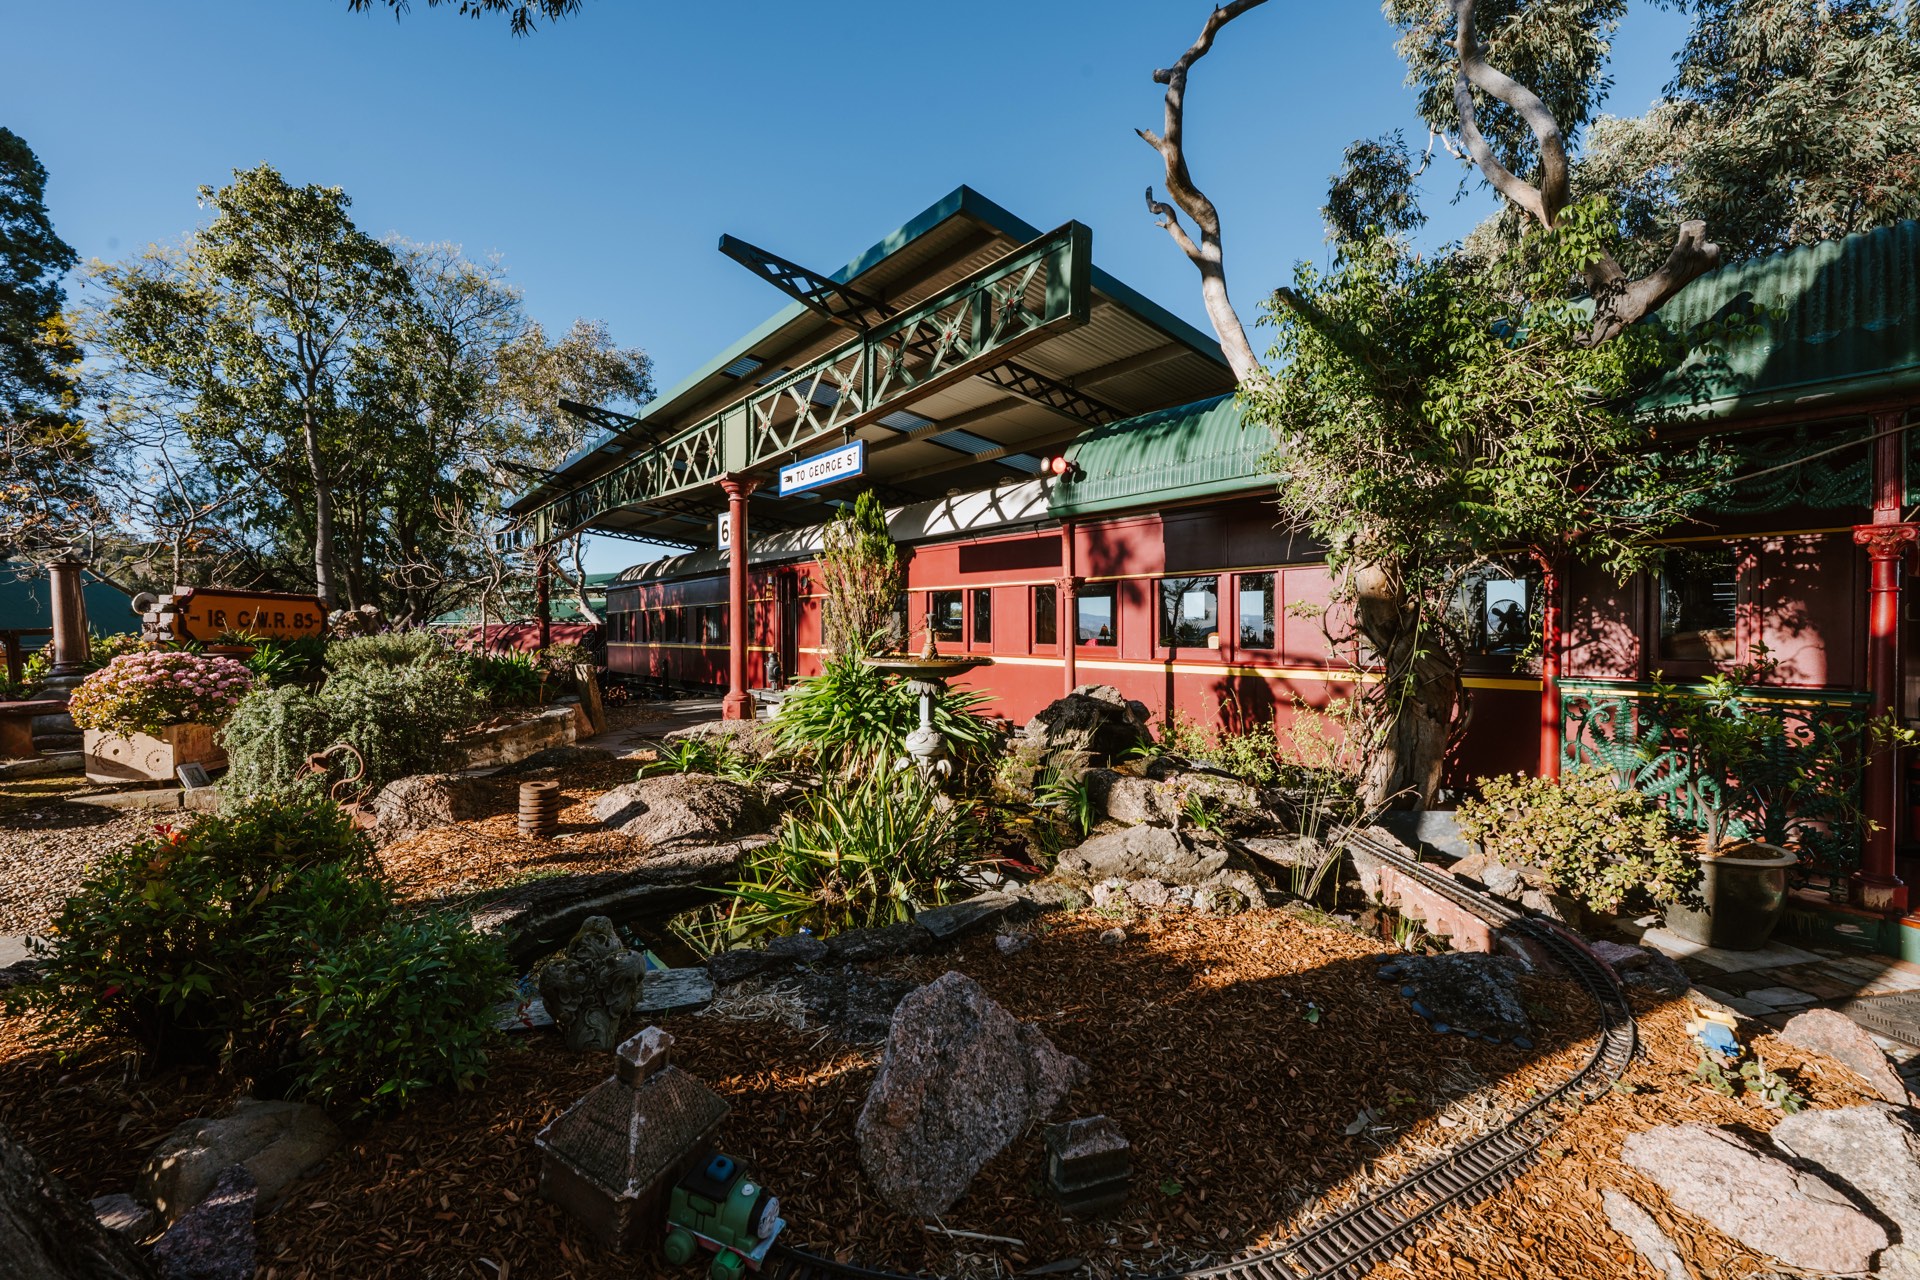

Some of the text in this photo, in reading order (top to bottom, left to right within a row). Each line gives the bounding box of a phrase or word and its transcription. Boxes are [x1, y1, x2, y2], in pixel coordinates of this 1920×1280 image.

[796, 470, 806, 482] TO
[809, 457, 842, 478] GEORGE
[721, 520, 730, 543] 6
